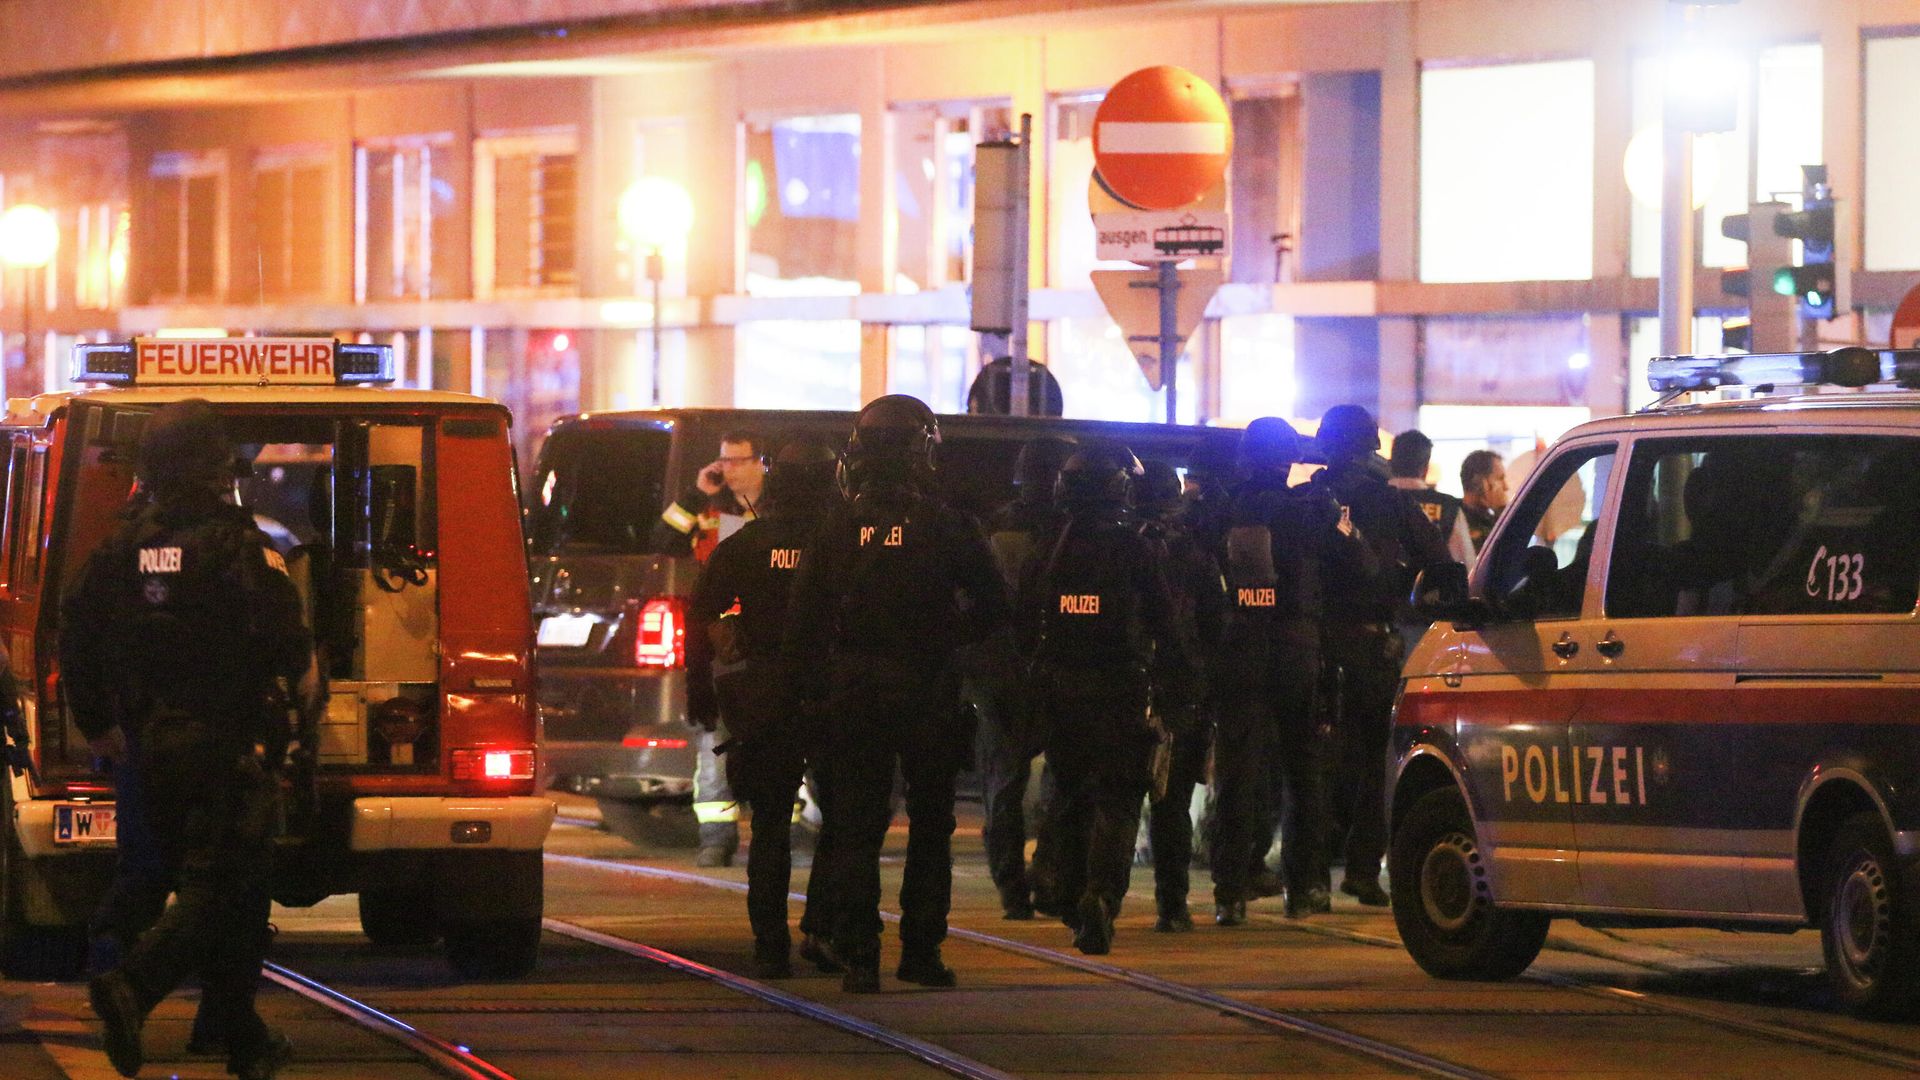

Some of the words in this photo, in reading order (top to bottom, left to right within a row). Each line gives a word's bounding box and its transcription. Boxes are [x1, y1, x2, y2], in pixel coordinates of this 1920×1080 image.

[139, 344, 331, 375] FEUERWEHR
[138, 546, 182, 573] POLIZEI
[1827, 553, 1864, 600] 133
[1060, 594, 1100, 614] POLIZEI
[1238, 588, 1275, 607] POLIZEI
[1501, 744, 1647, 805] POLIZEI
[76, 813, 92, 836] W
